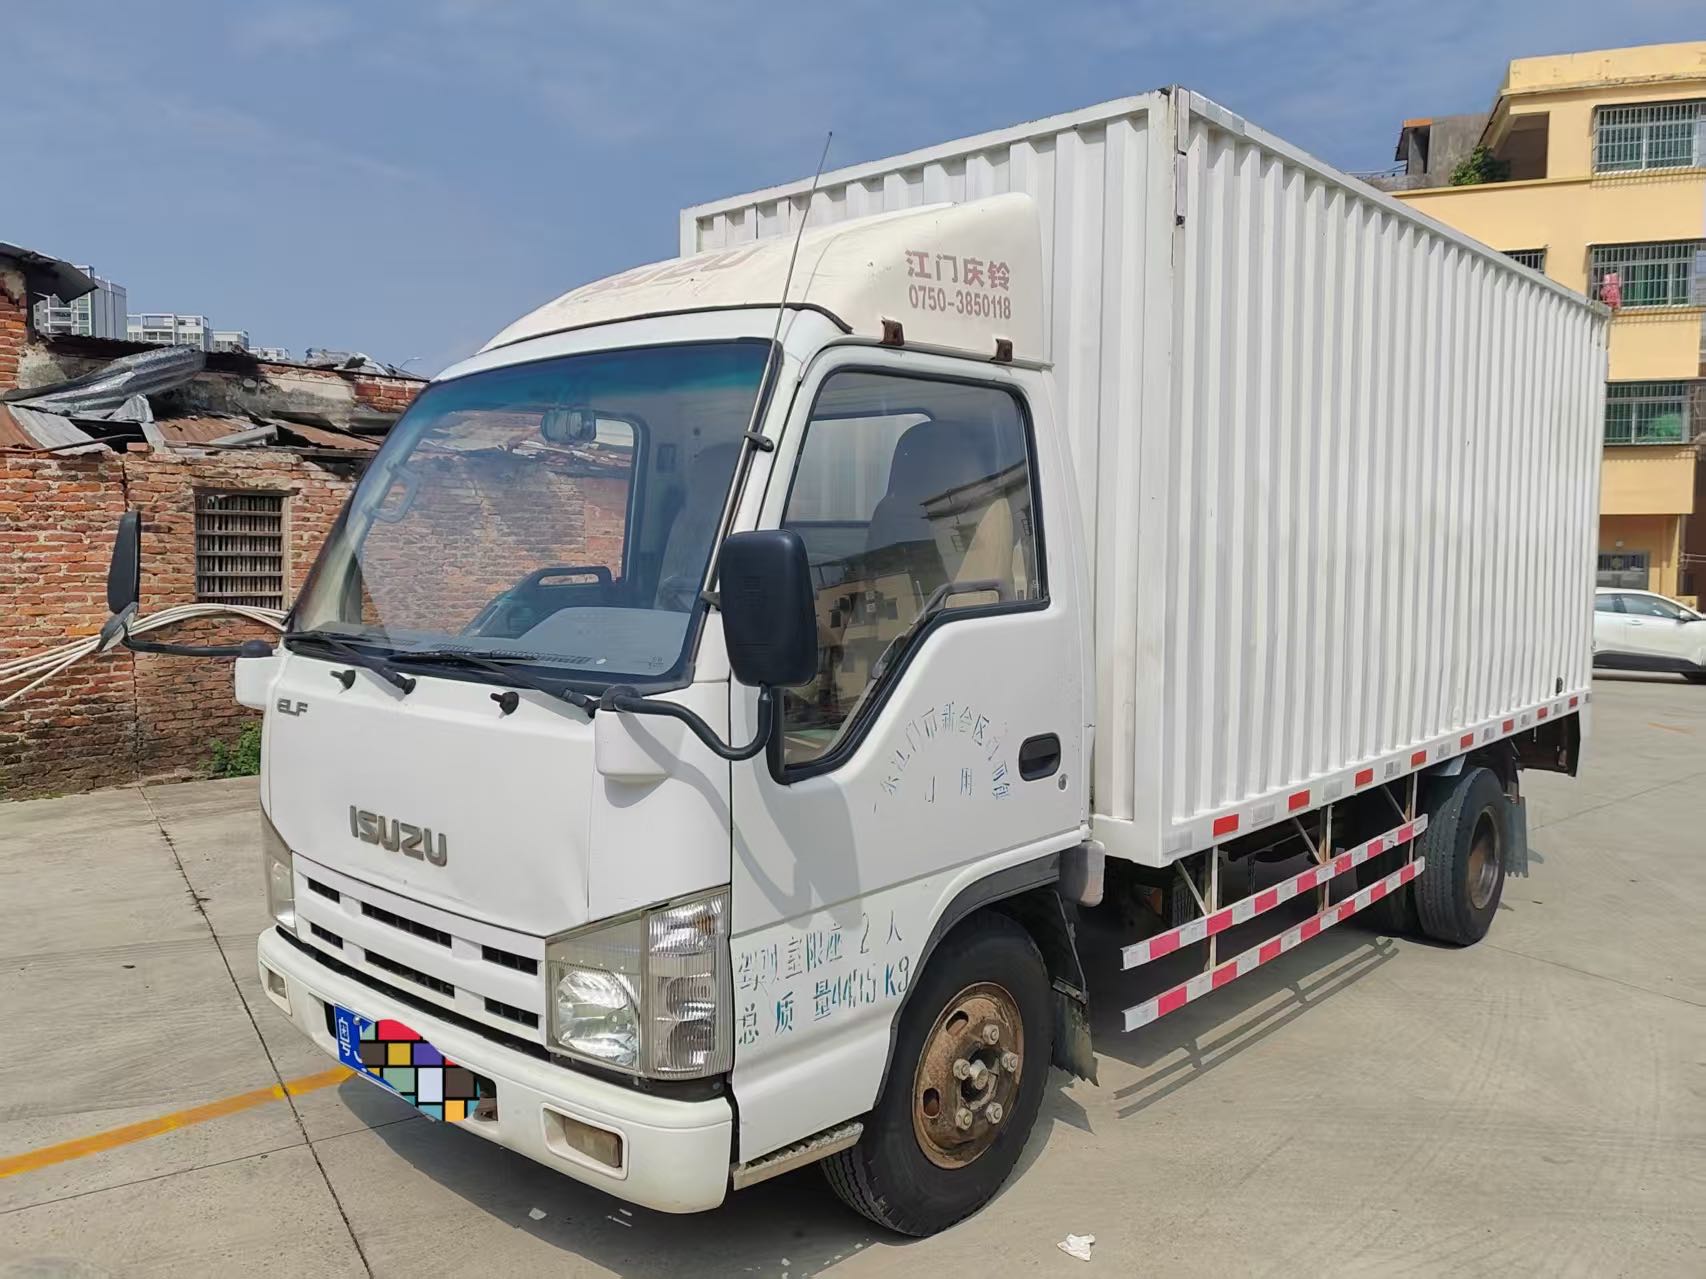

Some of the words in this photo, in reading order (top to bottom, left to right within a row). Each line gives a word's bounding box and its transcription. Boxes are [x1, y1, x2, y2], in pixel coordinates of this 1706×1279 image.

[904, 249, 1011, 291] 江门庆铃
[908, 284, 1012, 319] 0750-3850118
[276, 698, 308, 717] ELF
[349, 804, 448, 867] ISUZU
